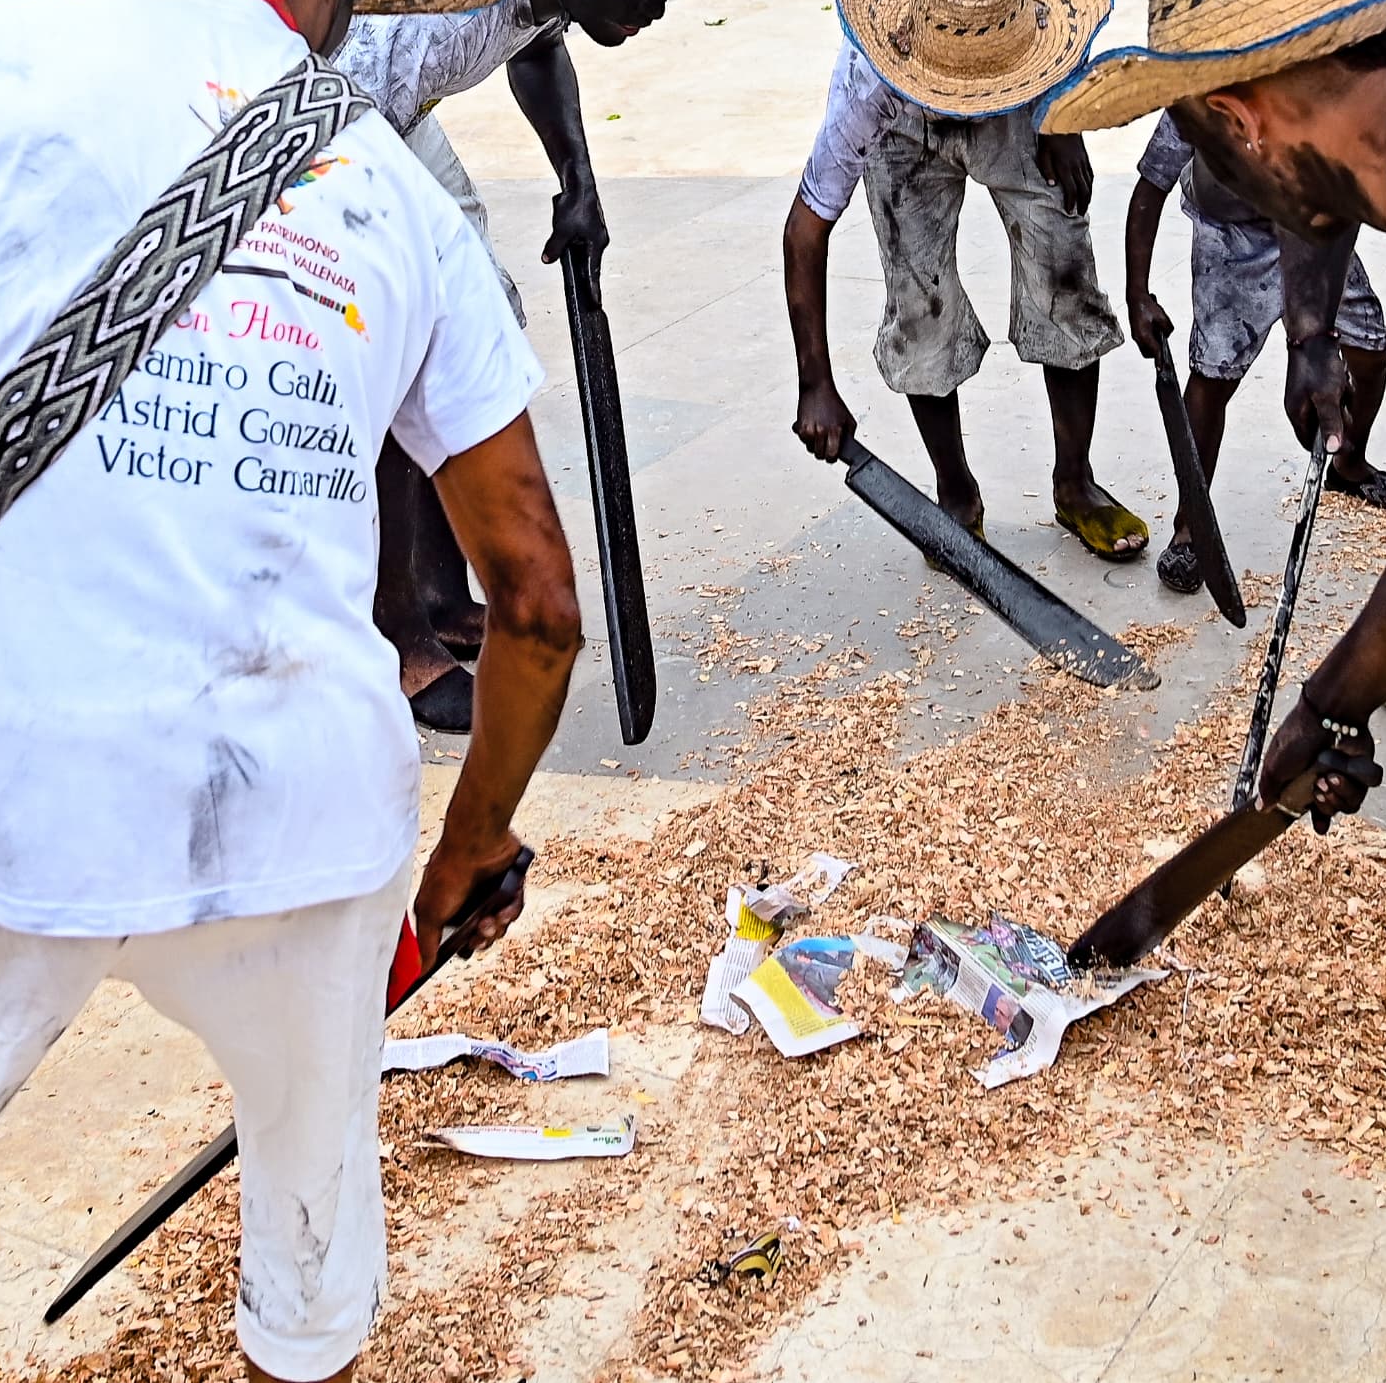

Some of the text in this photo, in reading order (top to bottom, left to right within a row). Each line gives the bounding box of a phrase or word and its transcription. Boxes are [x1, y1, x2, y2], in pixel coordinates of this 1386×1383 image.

[235, 239, 356, 296] EYEND VALLENATA
[260, 221, 340, 263] PATRIMONIO
[228, 300, 324, 351] Hono
[134, 349, 248, 391] amiro
[98, 385, 219, 439] Astrid
[97, 434, 367, 504] Victor Camarillo
